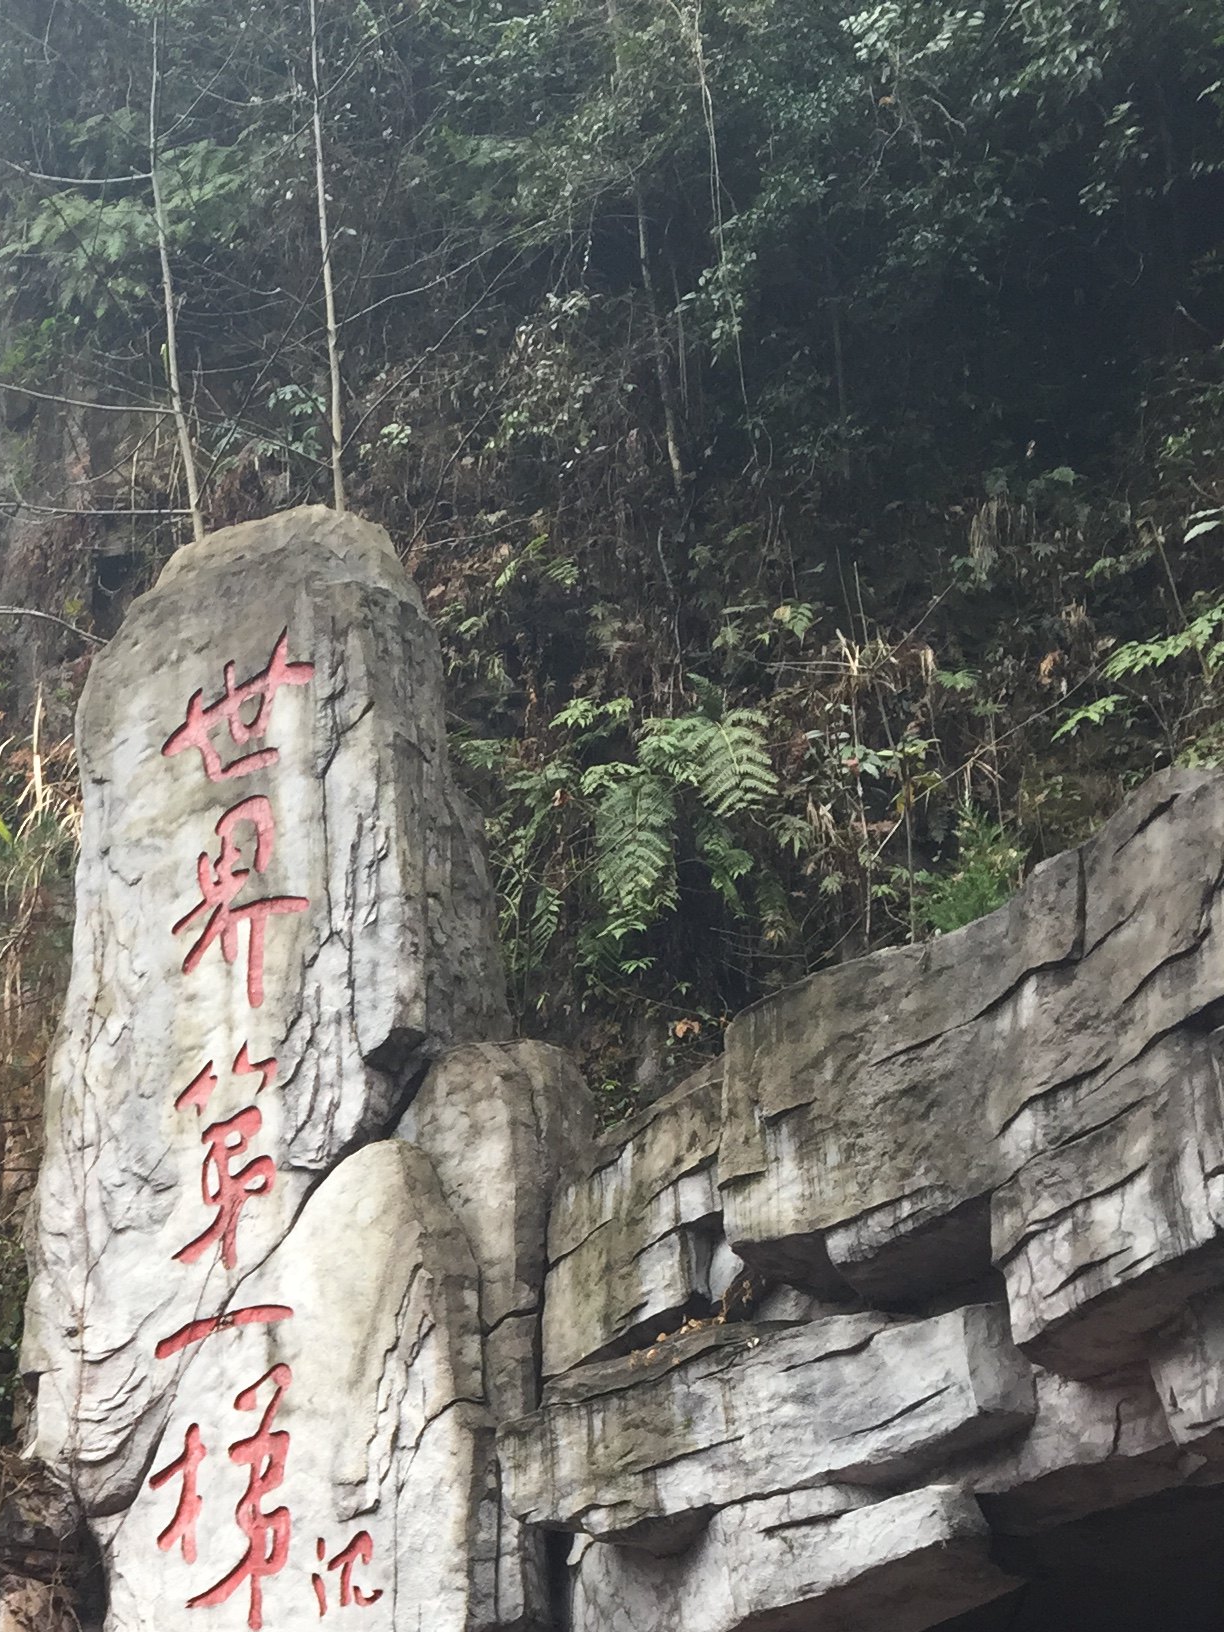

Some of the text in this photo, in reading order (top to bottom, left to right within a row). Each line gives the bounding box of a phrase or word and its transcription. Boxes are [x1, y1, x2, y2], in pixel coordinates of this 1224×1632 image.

[149, 626, 316, 1631] 世界第一梯
